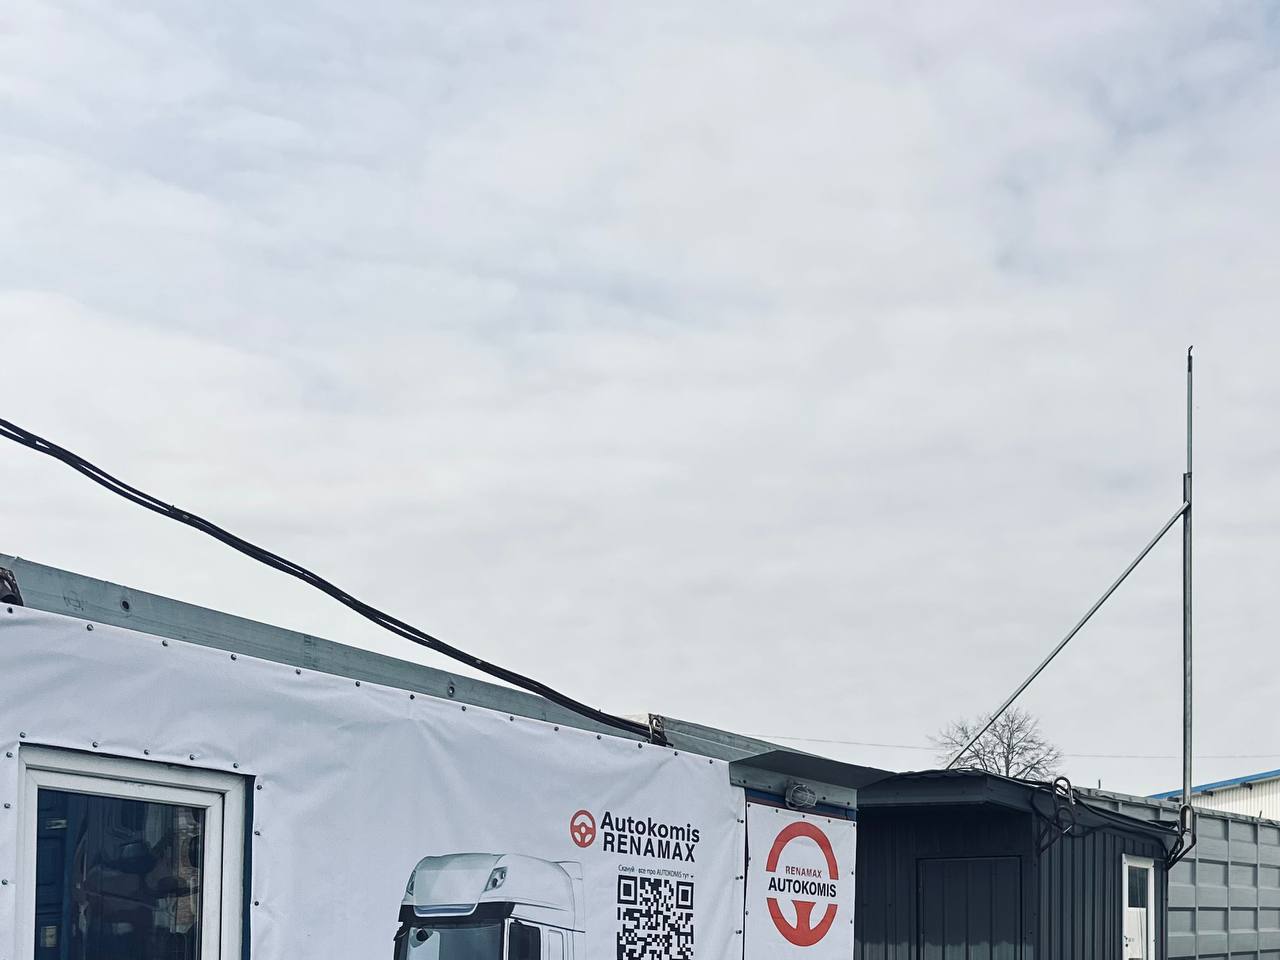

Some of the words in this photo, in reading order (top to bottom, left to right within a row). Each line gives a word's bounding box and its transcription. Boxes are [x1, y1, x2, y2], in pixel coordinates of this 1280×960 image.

[600, 811, 700, 843] Autokomis
[603, 831, 695, 863] RENAMAX
[785, 865, 822, 879] RENAMAX
[768, 877, 837, 898] AUTOKOMIS
